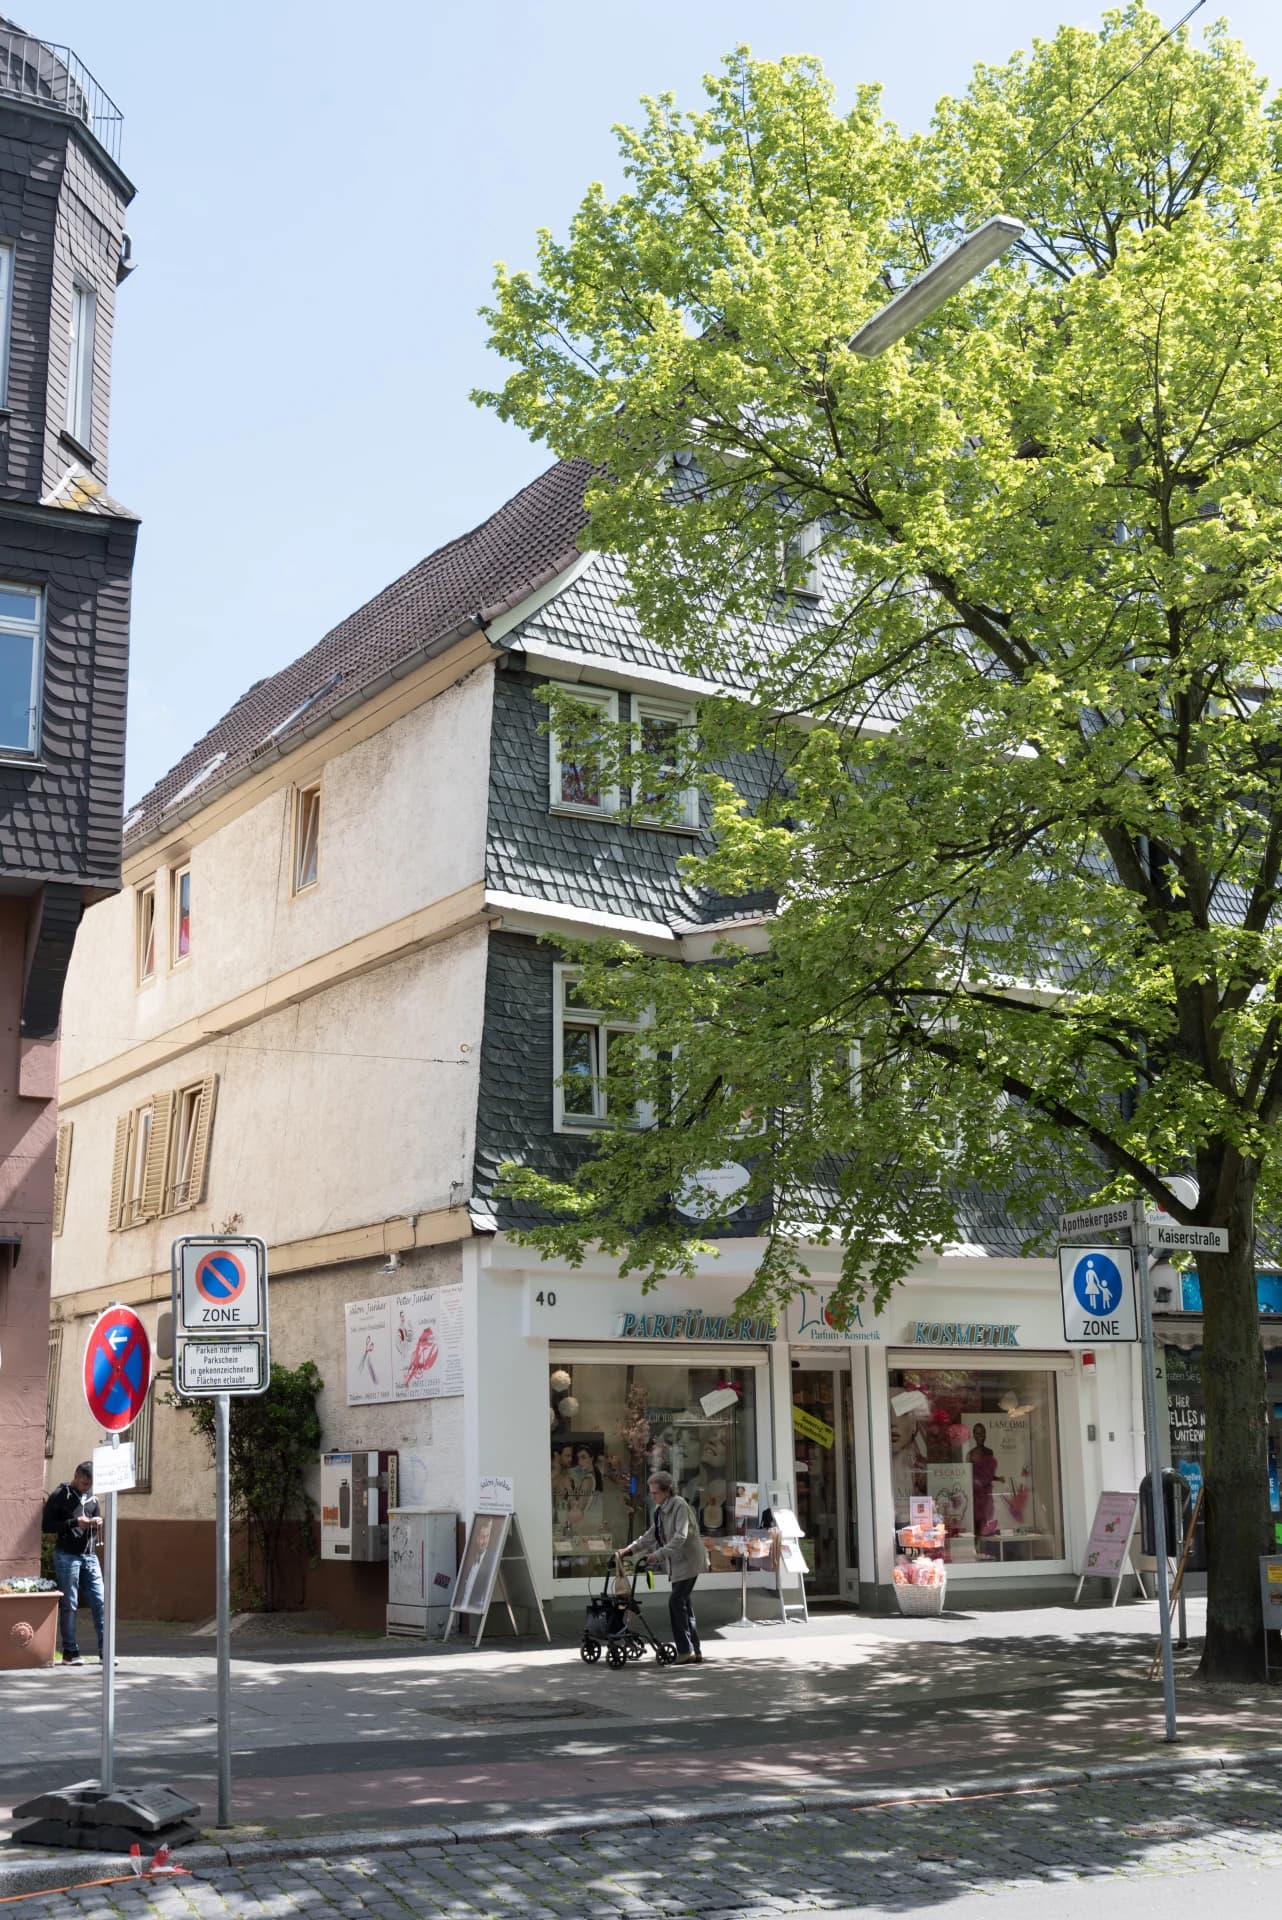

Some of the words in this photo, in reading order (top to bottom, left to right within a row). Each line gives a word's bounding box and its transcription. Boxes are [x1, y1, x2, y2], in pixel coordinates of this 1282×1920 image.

[1062, 1208, 1128, 1233] Apothekergasse
[1158, 1228, 1221, 1246] Kaiserstraße
[536, 1291, 557, 1306] 40
[202, 1308, 241, 1322] ZONE
[798, 1288, 864, 1334] Lia
[621, 1308, 777, 1342] PARFÜMERIE
[1082, 1320, 1120, 1336] ZONE
[811, 1329, 839, 1340] Parfum
[913, 1321, 1020, 1347] KOSMETIK
[196, 1346, 218, 1355] Parken
[231, 1346, 242, 1354] mit
[203, 1356, 239, 1364] Parkschein
[190, 1367, 197, 1375] in
[198, 1366, 254, 1377] gekennzeichneten
[223, 1375, 246, 1385] erlaubt
